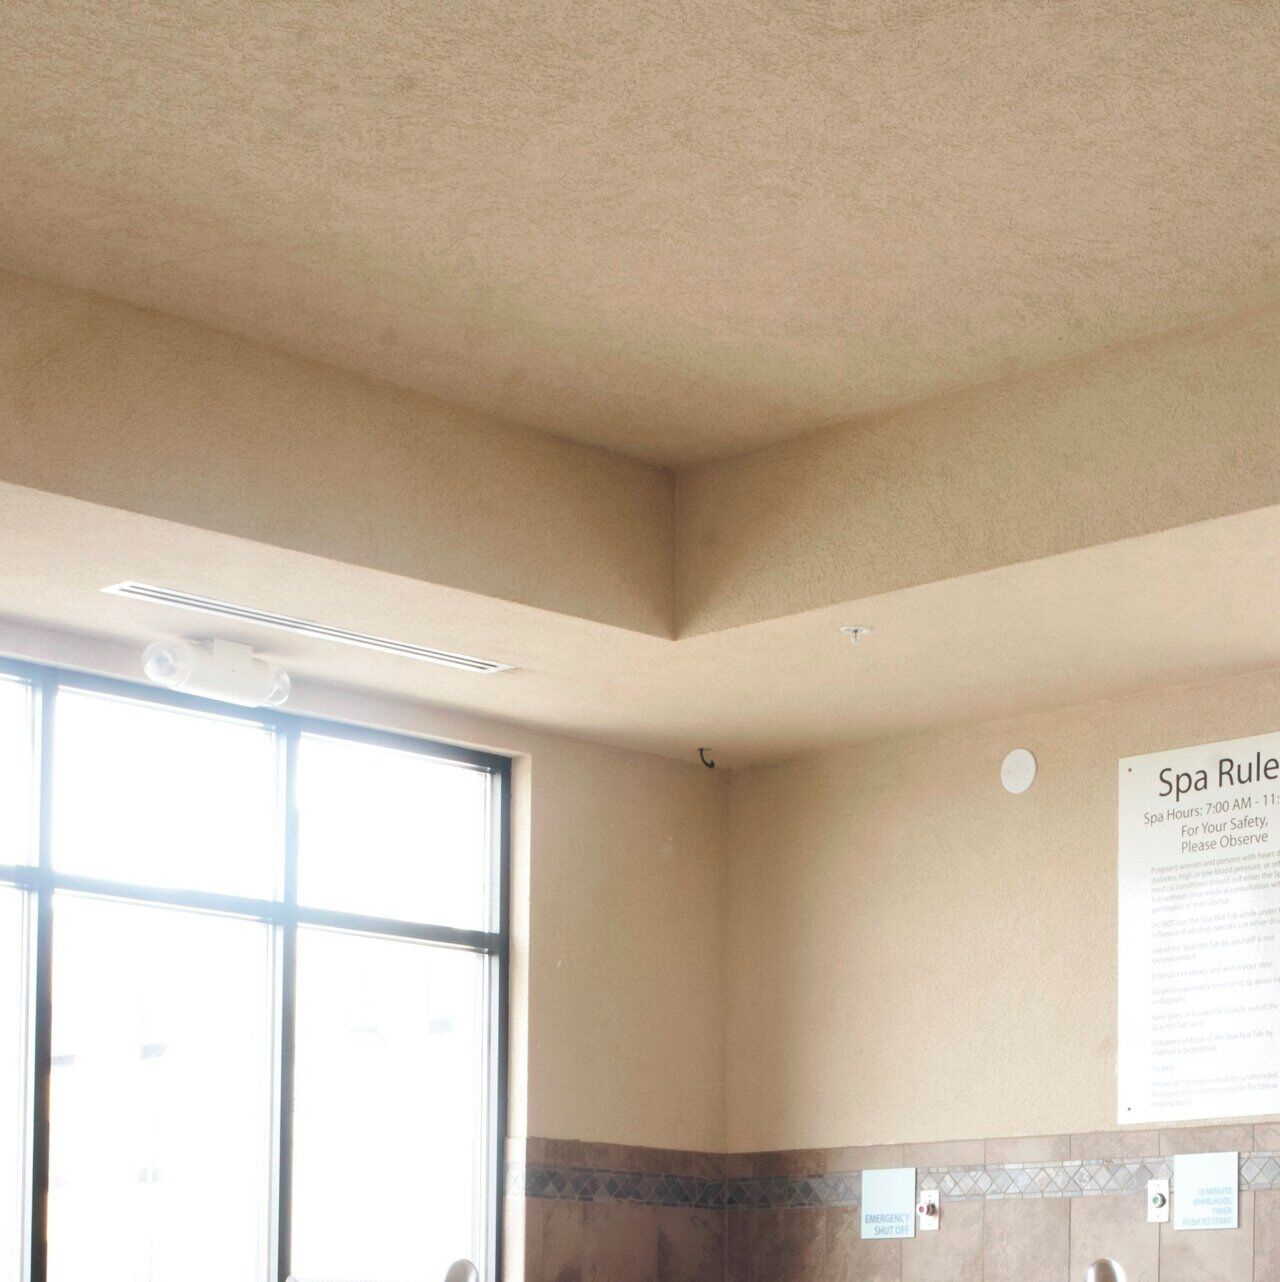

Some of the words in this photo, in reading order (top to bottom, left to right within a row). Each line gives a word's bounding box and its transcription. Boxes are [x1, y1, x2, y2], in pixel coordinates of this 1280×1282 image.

[1159, 767, 1208, 803] Spa
[1144, 812, 1164, 826] Spa
[1167, 806, 1203, 821] Hours:
[1206, 800, 1229, 816] 7:00
[1232, 797, 1252, 811] AM
[1181, 825, 1199, 838] For
[1201, 820, 1227, 835] Your
[1230, 815, 1269, 831] Safety,
[1181, 840, 1217, 854] Please
[1220, 832, 1269, 848] Observe
[865, 1213, 909, 1224] EMERGENCY
[1212, 1207, 1232, 1215] TIMER
[1183, 1217, 1200, 1226] PUSH
[1201, 1217, 1210, 1226] TO
[1211, 1216, 1232, 1225] START
[874, 1226, 893, 1236] SHUT
[895, 1225, 909, 1235] OFF
